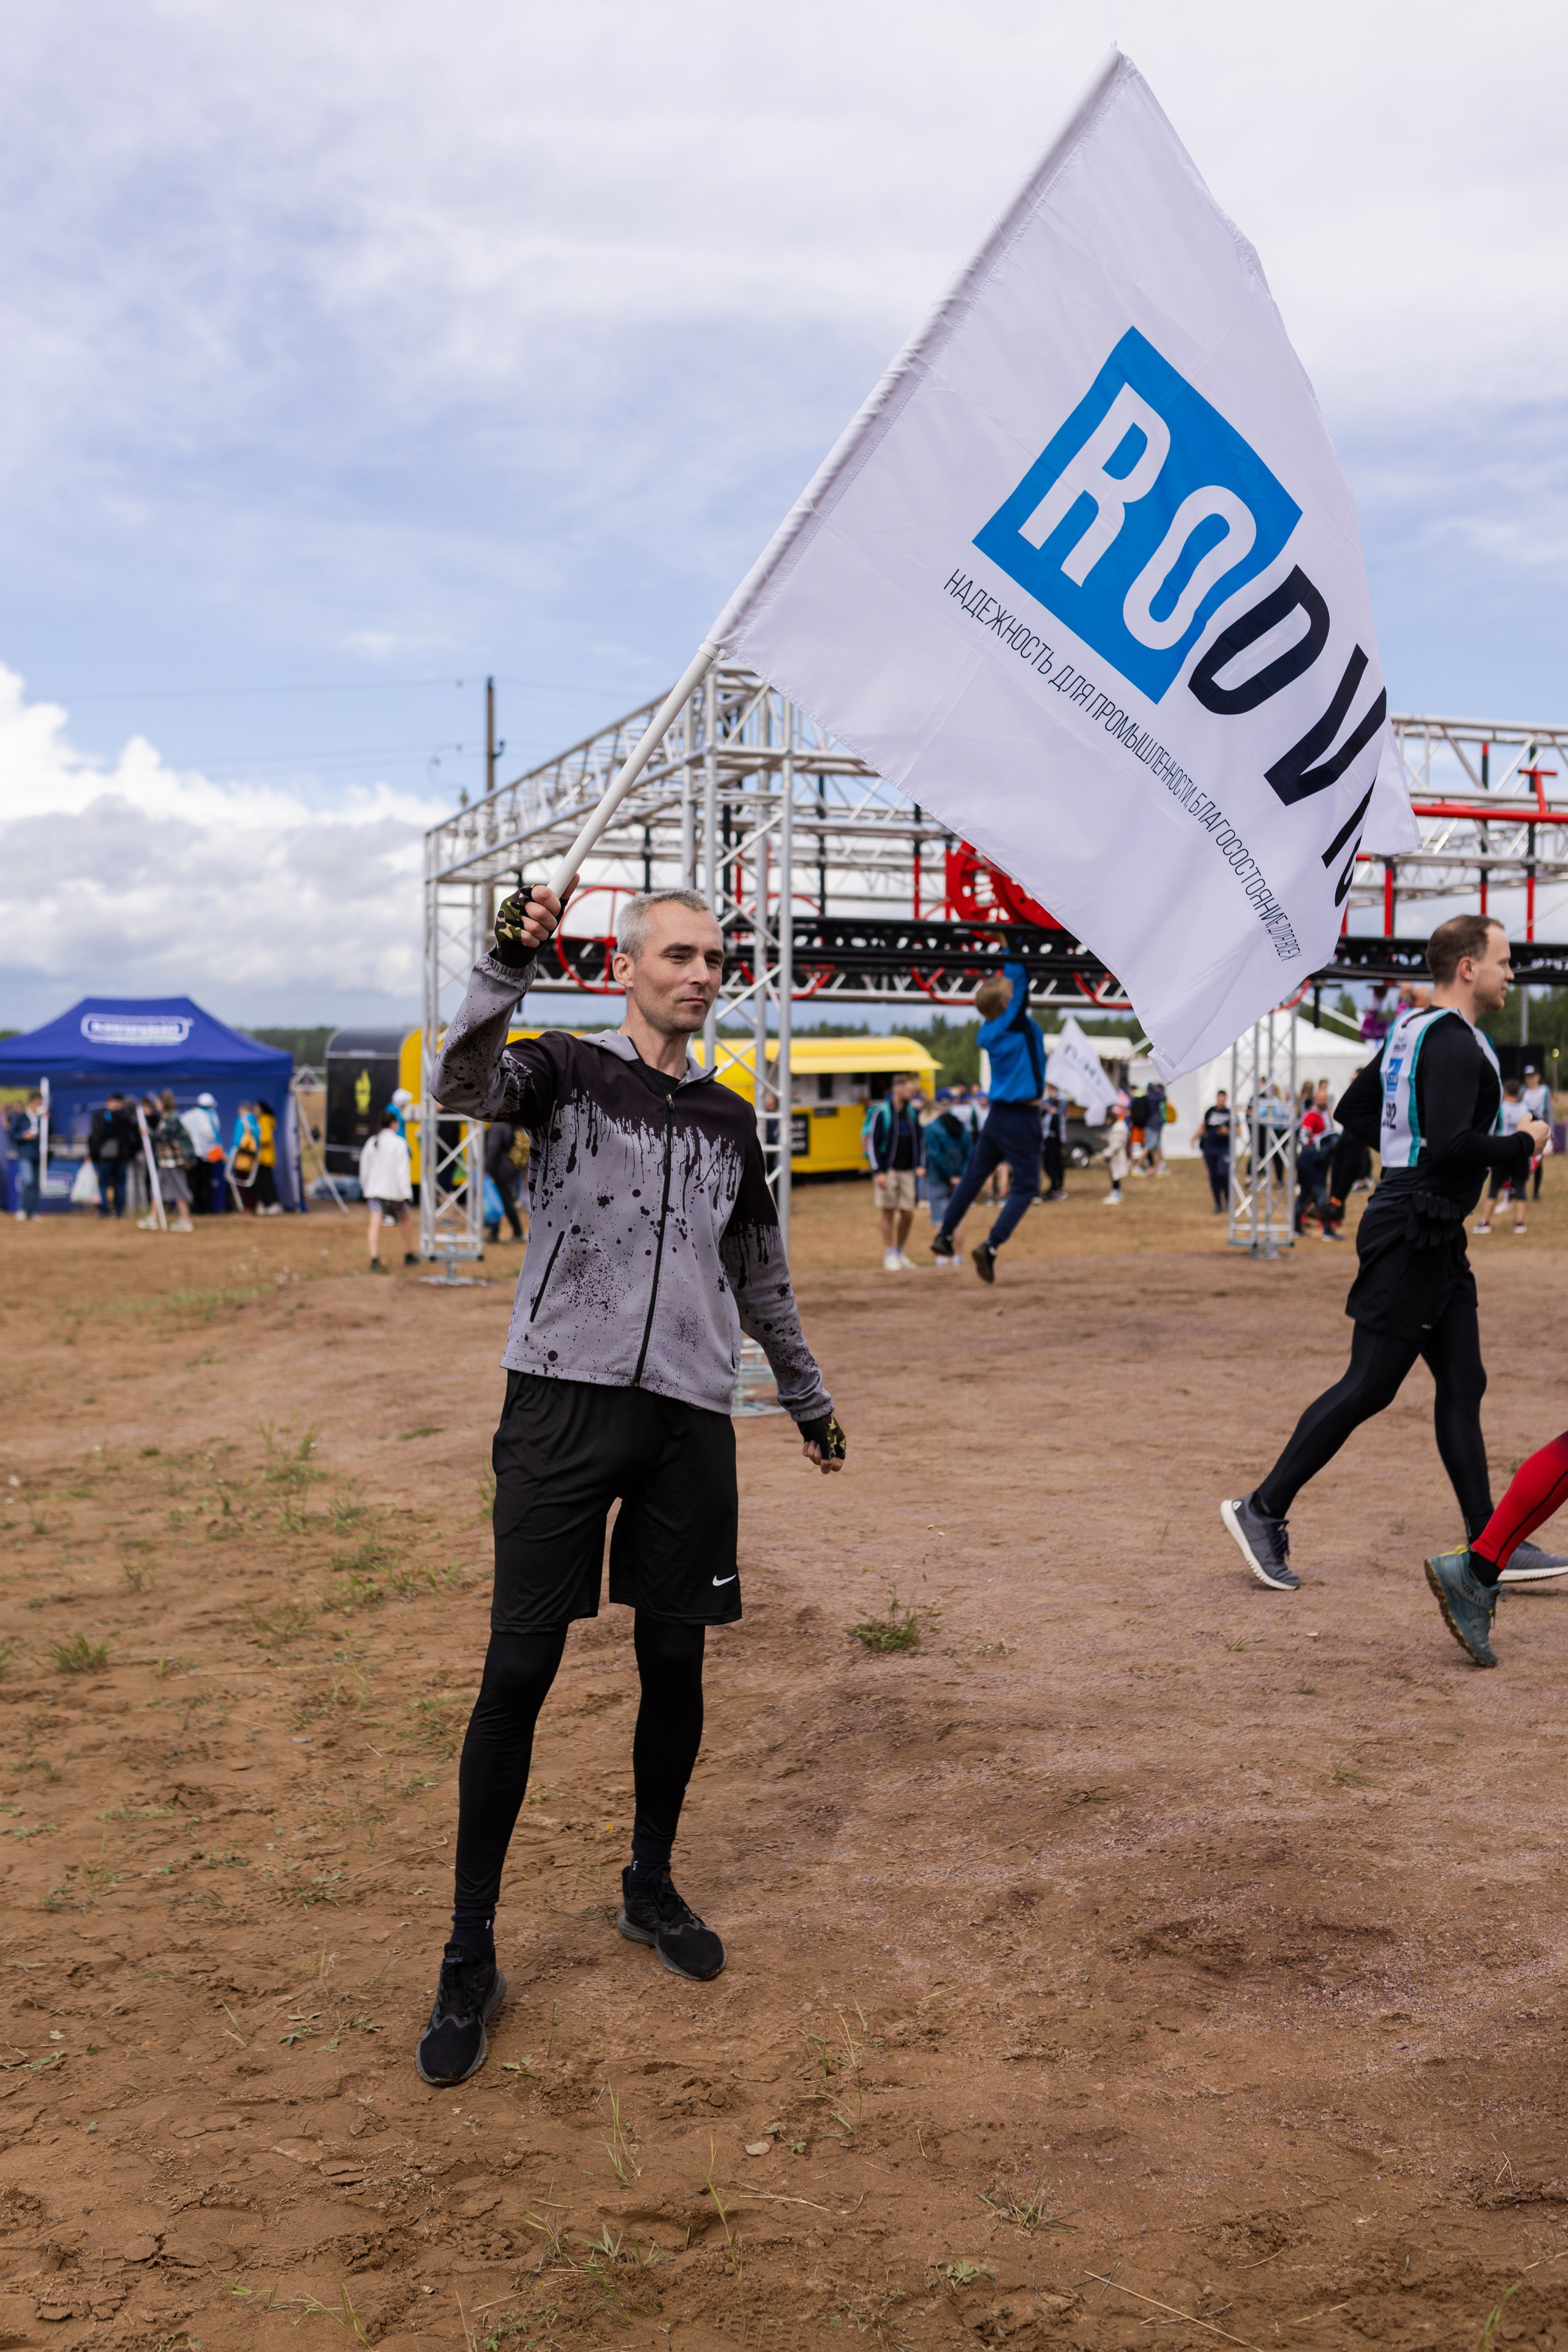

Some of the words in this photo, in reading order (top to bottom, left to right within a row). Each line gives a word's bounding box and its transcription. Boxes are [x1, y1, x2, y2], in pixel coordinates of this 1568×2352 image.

[943, 568, 1055, 675] НАДЕЖНОСТЬ
[1047, 665, 1096, 707] ДЛЯ
[1085, 693, 1198, 810] ПРОМЫШЛЕННОСТИ,
[1188, 792, 1289, 929] БЛАГОСОСТОЯНИЕ
[1264, 923, 1295, 943] ДЛЯ
[1274, 939, 1303, 962] ВСЕХ
